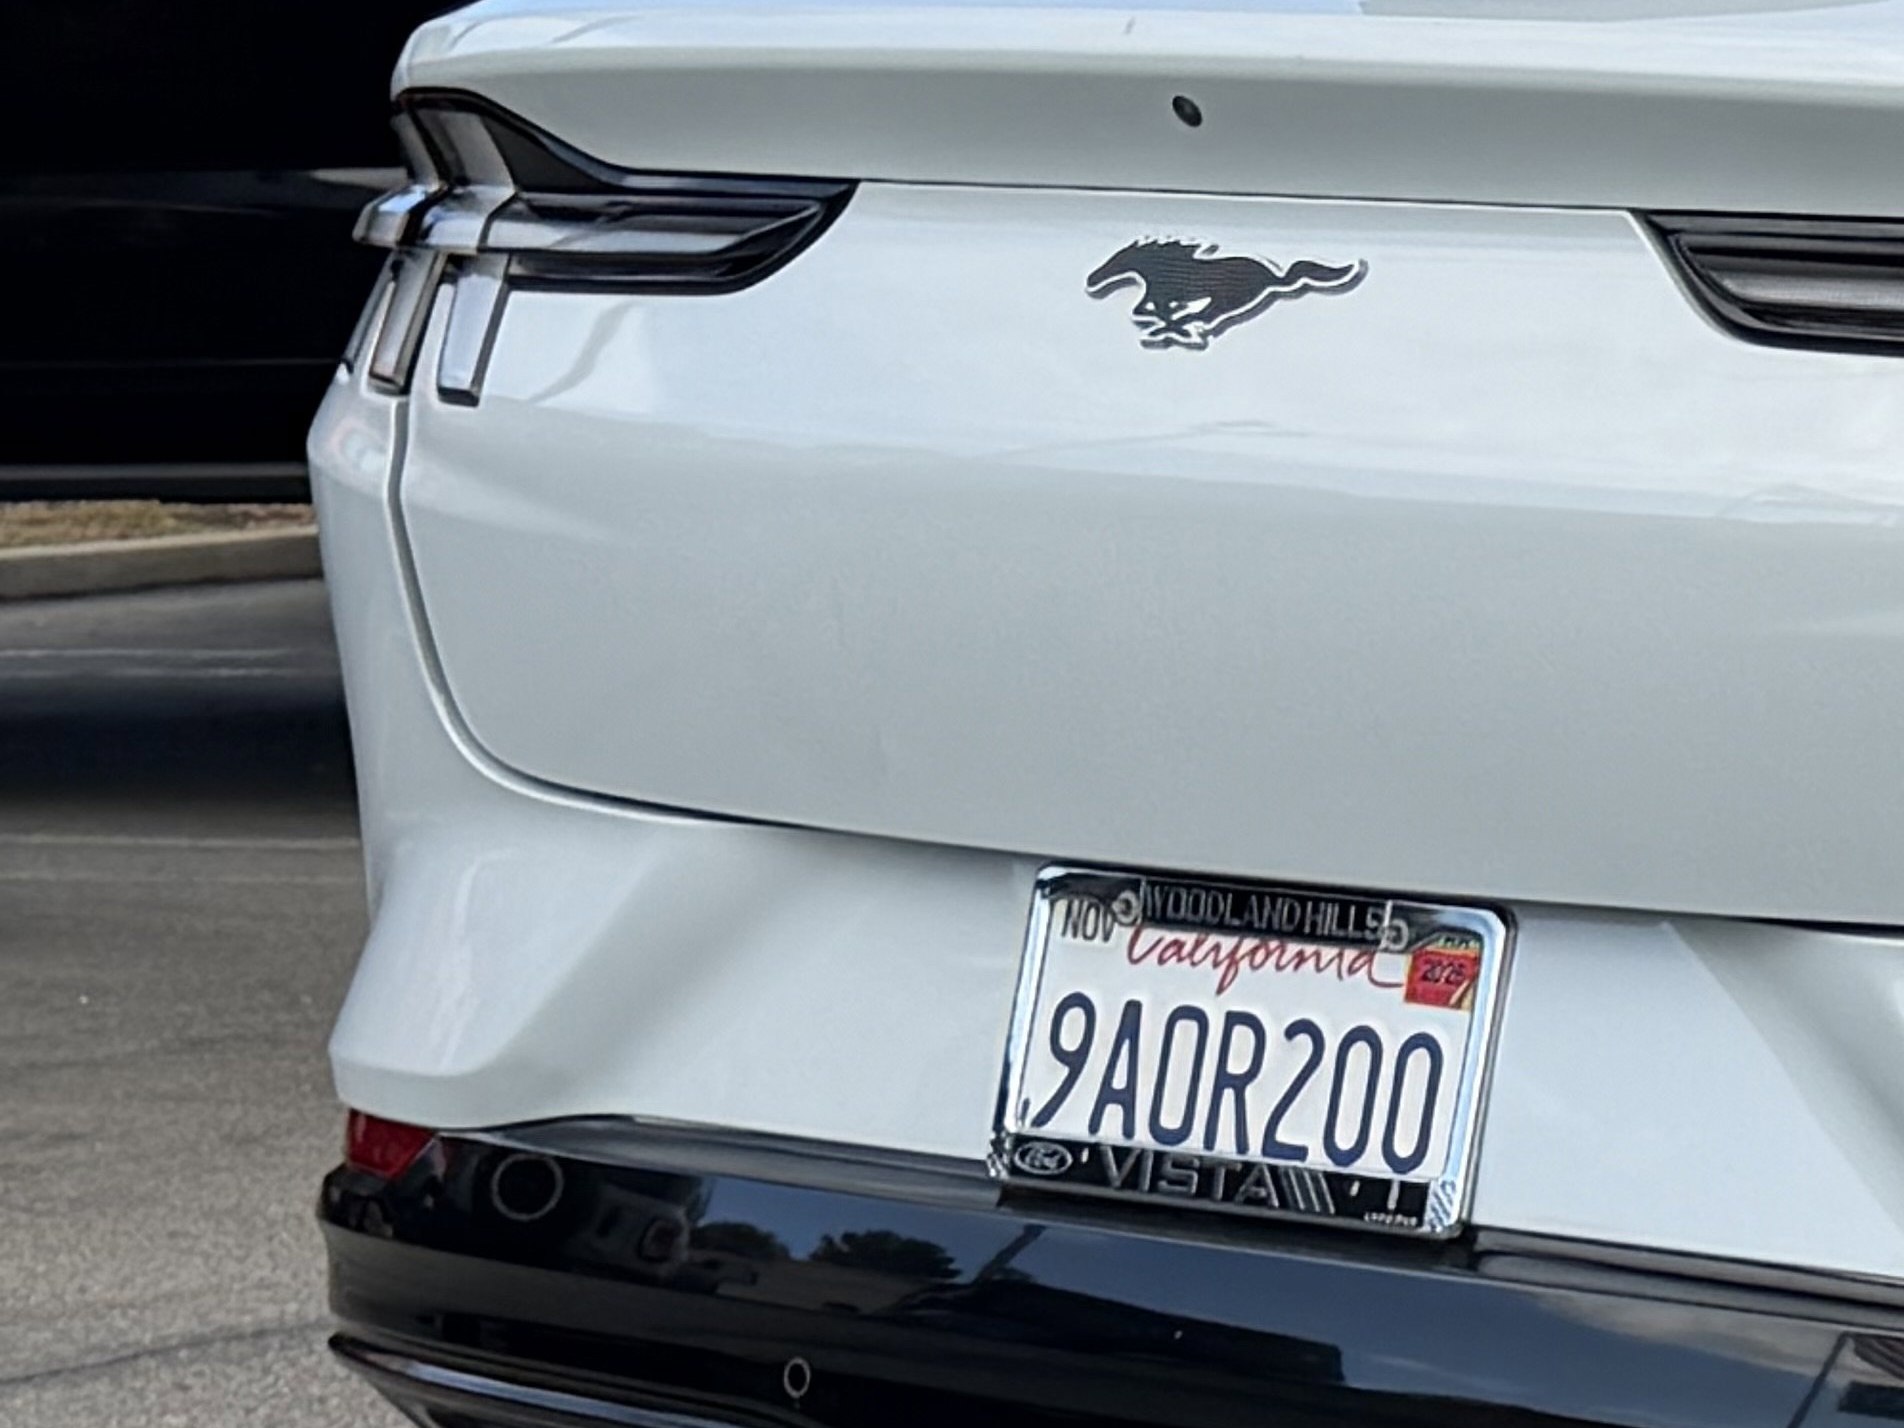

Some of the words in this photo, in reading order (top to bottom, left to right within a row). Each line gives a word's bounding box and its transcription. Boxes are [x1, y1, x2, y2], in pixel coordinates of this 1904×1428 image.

[1143, 884, 1300, 932] WOODLAND
[1303, 900, 1386, 941] HILLS
[1127, 927, 1405, 995] California
[1101, 1145, 1279, 1208] VISTA
